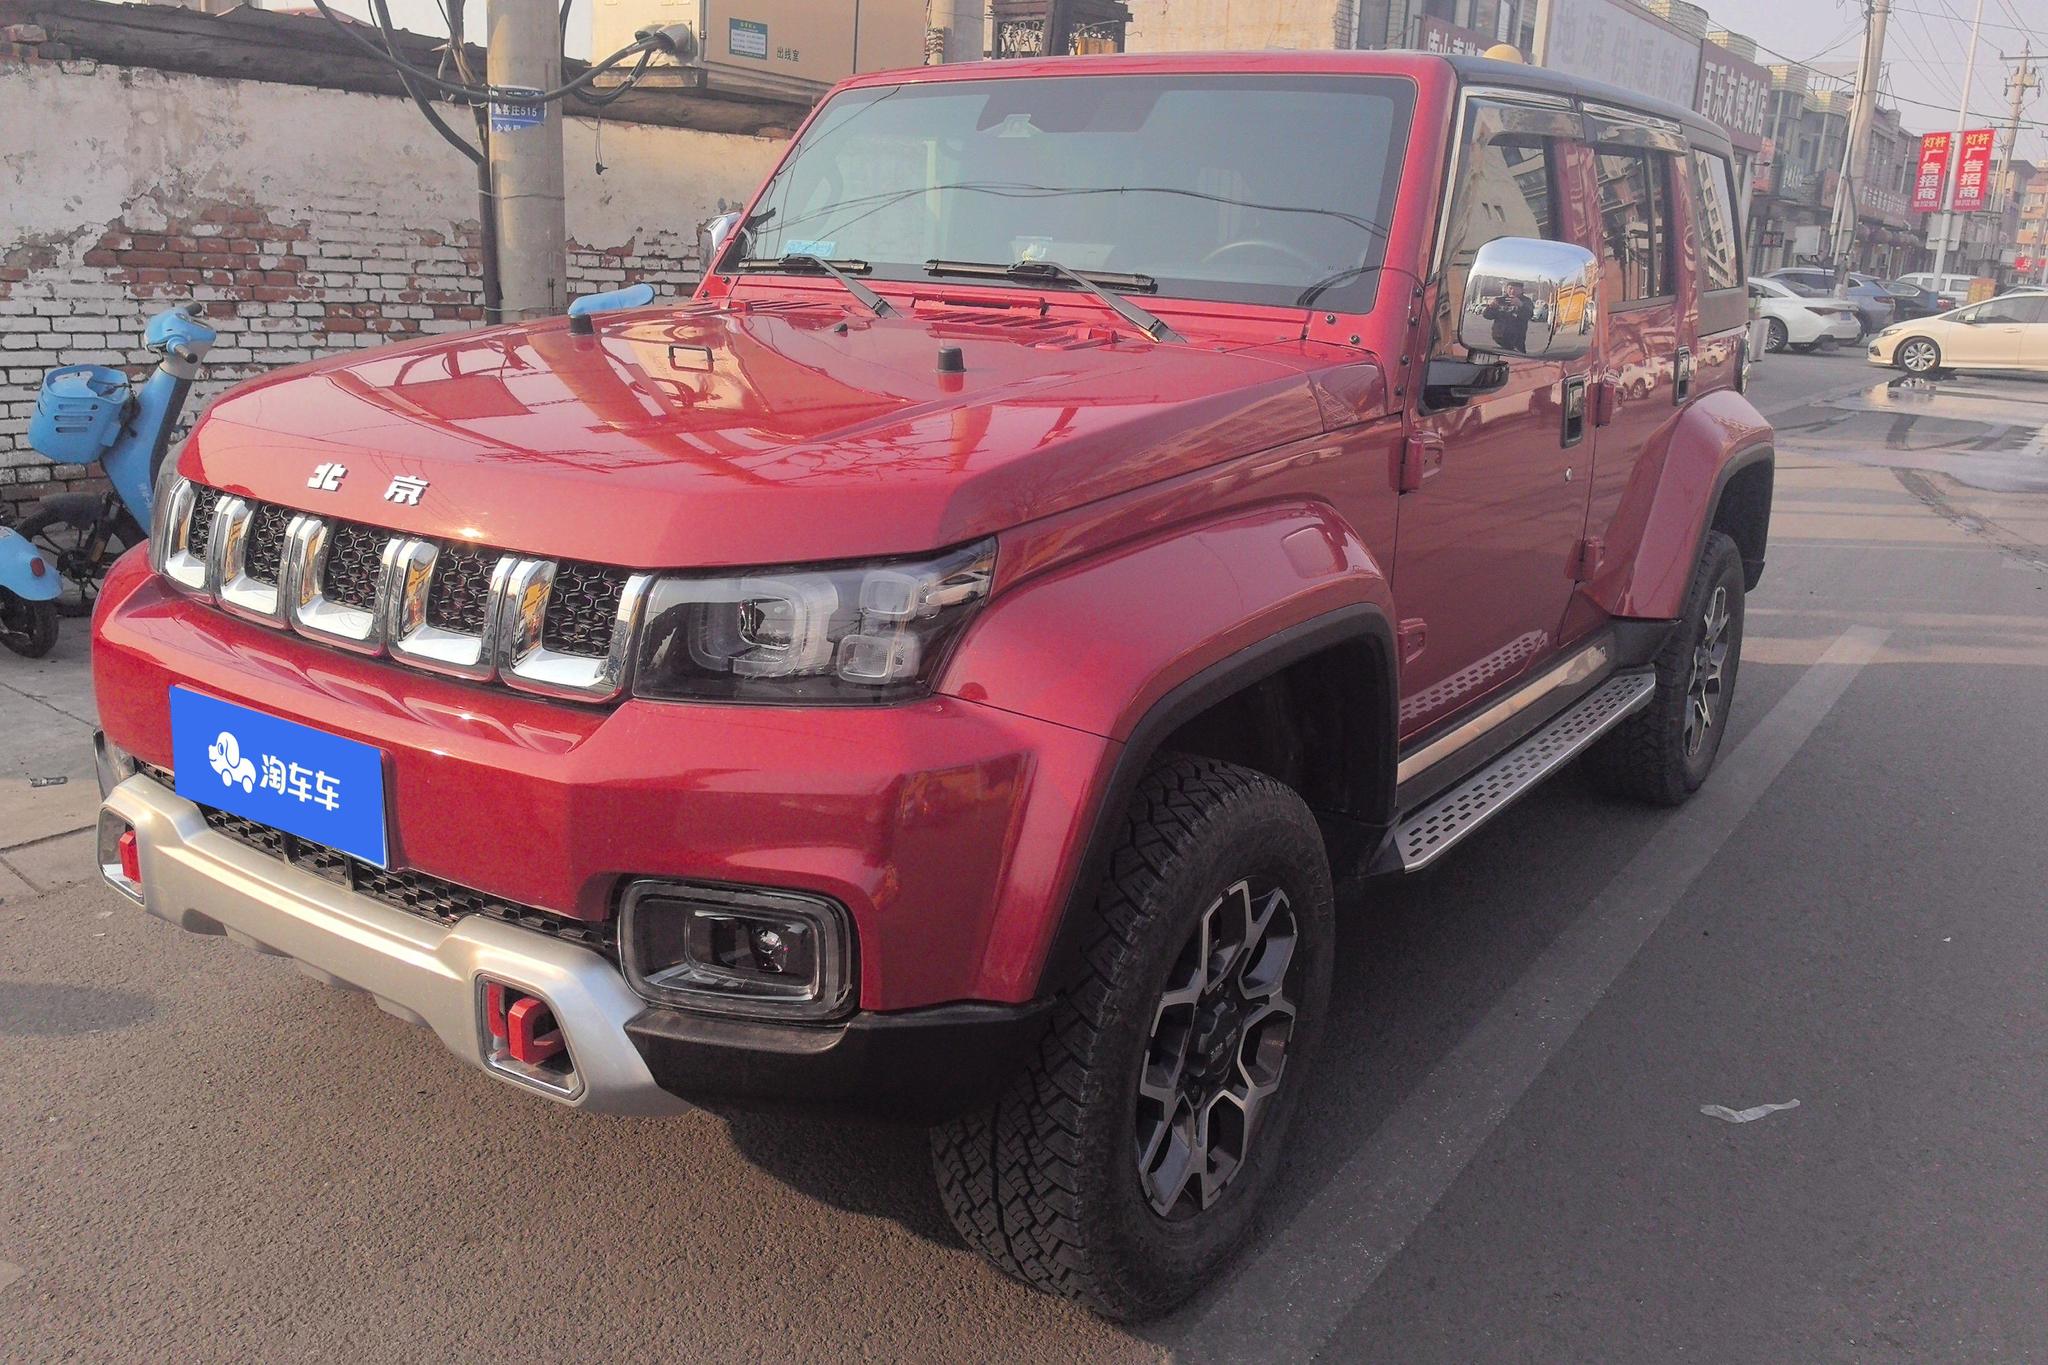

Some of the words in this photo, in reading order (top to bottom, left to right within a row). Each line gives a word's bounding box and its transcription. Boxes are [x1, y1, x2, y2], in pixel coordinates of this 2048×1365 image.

[1702, 61, 1768, 136] 百乐友便利店
[1924, 136, 1947, 148] 灯杆
[1965, 133, 1989, 145] 灯杆
[1917, 149, 1944, 200] 广告招商
[1959, 146, 1987, 198] 广告招商
[307, 462, 430, 506] 北京
